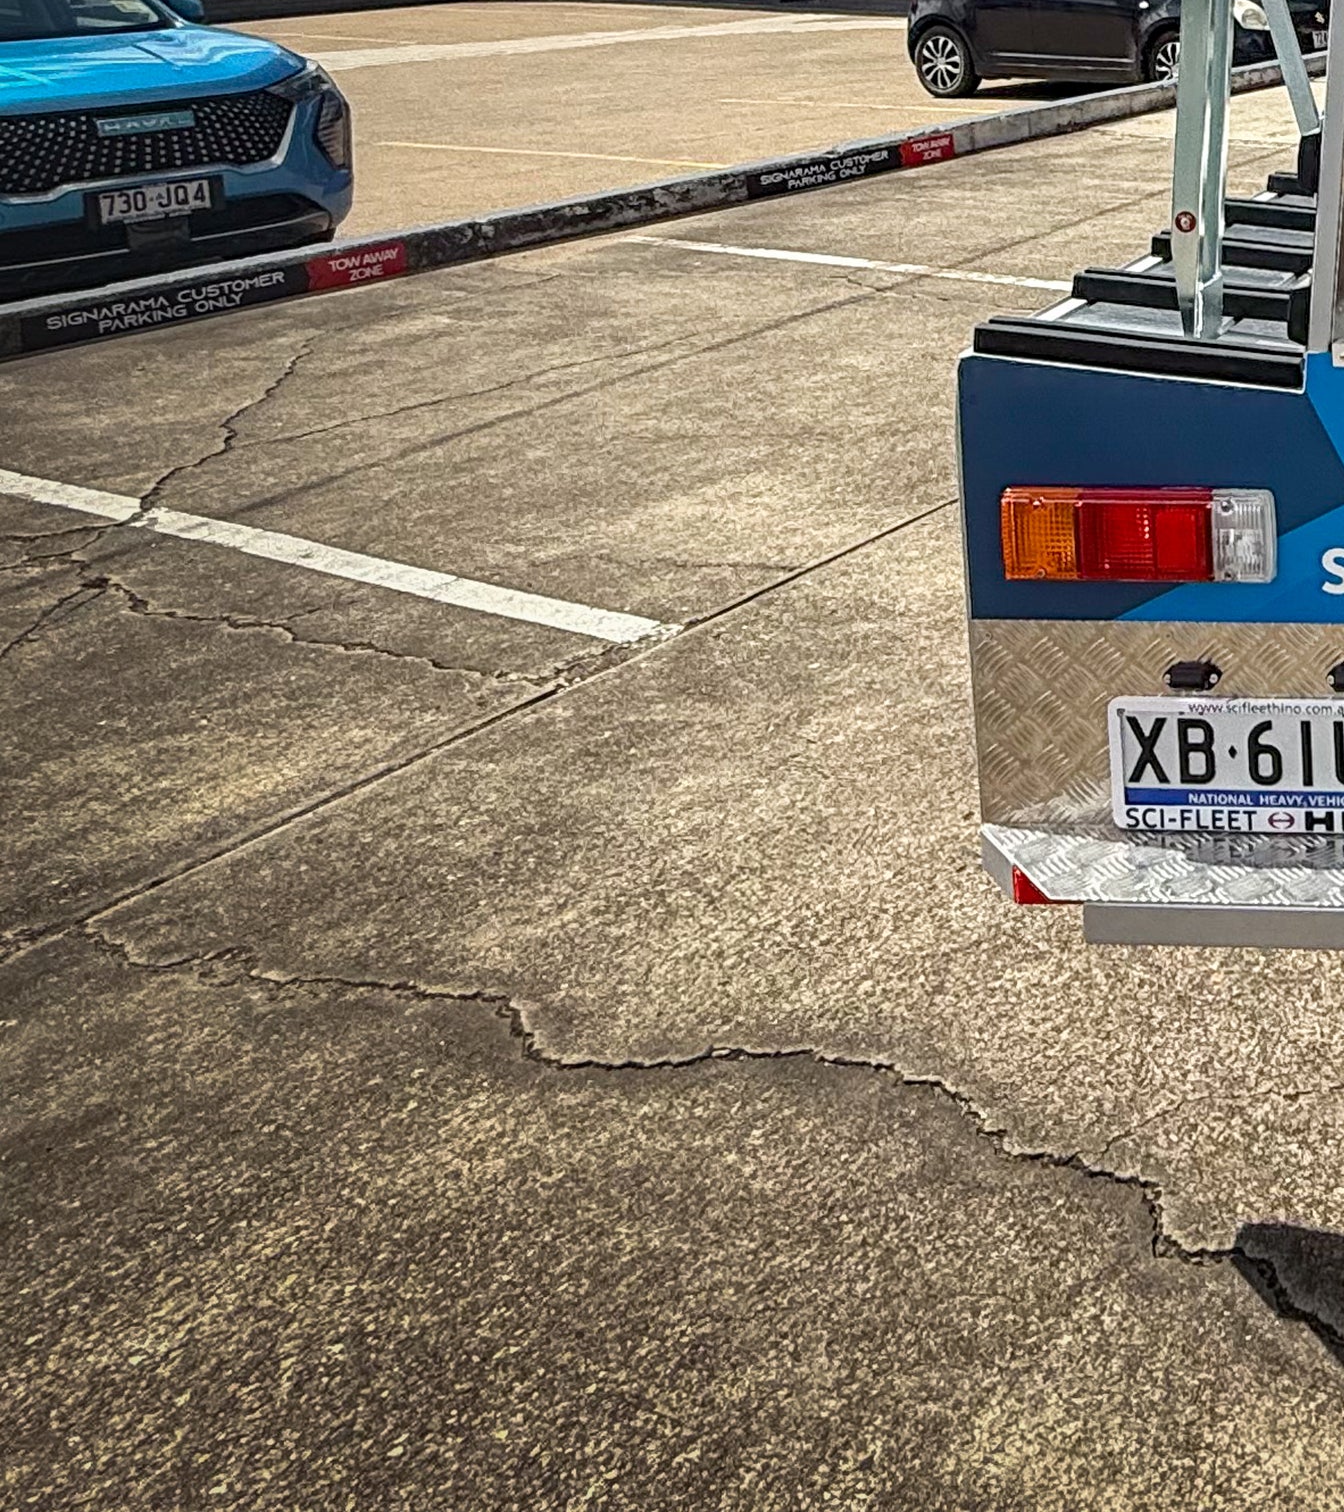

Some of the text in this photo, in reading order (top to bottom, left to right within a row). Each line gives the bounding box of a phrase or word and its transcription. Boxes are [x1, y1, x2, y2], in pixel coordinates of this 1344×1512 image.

[830, 150, 889, 171] CUSTOMER
[788, 164, 866, 189] PARKING ONLY
[328, 248, 399, 272] TOW AWAY
[349, 264, 384, 281] ZONE
[46, 271, 285, 330] SIGNARAMA CUSTOMER
[100, 292, 244, 333] PARKING ONLY
[1188, 793, 1253, 807] NATIONAL
[1260, 794, 1303, 807] HEAVY
[1125, 807, 1257, 831] SCI-FLEET
